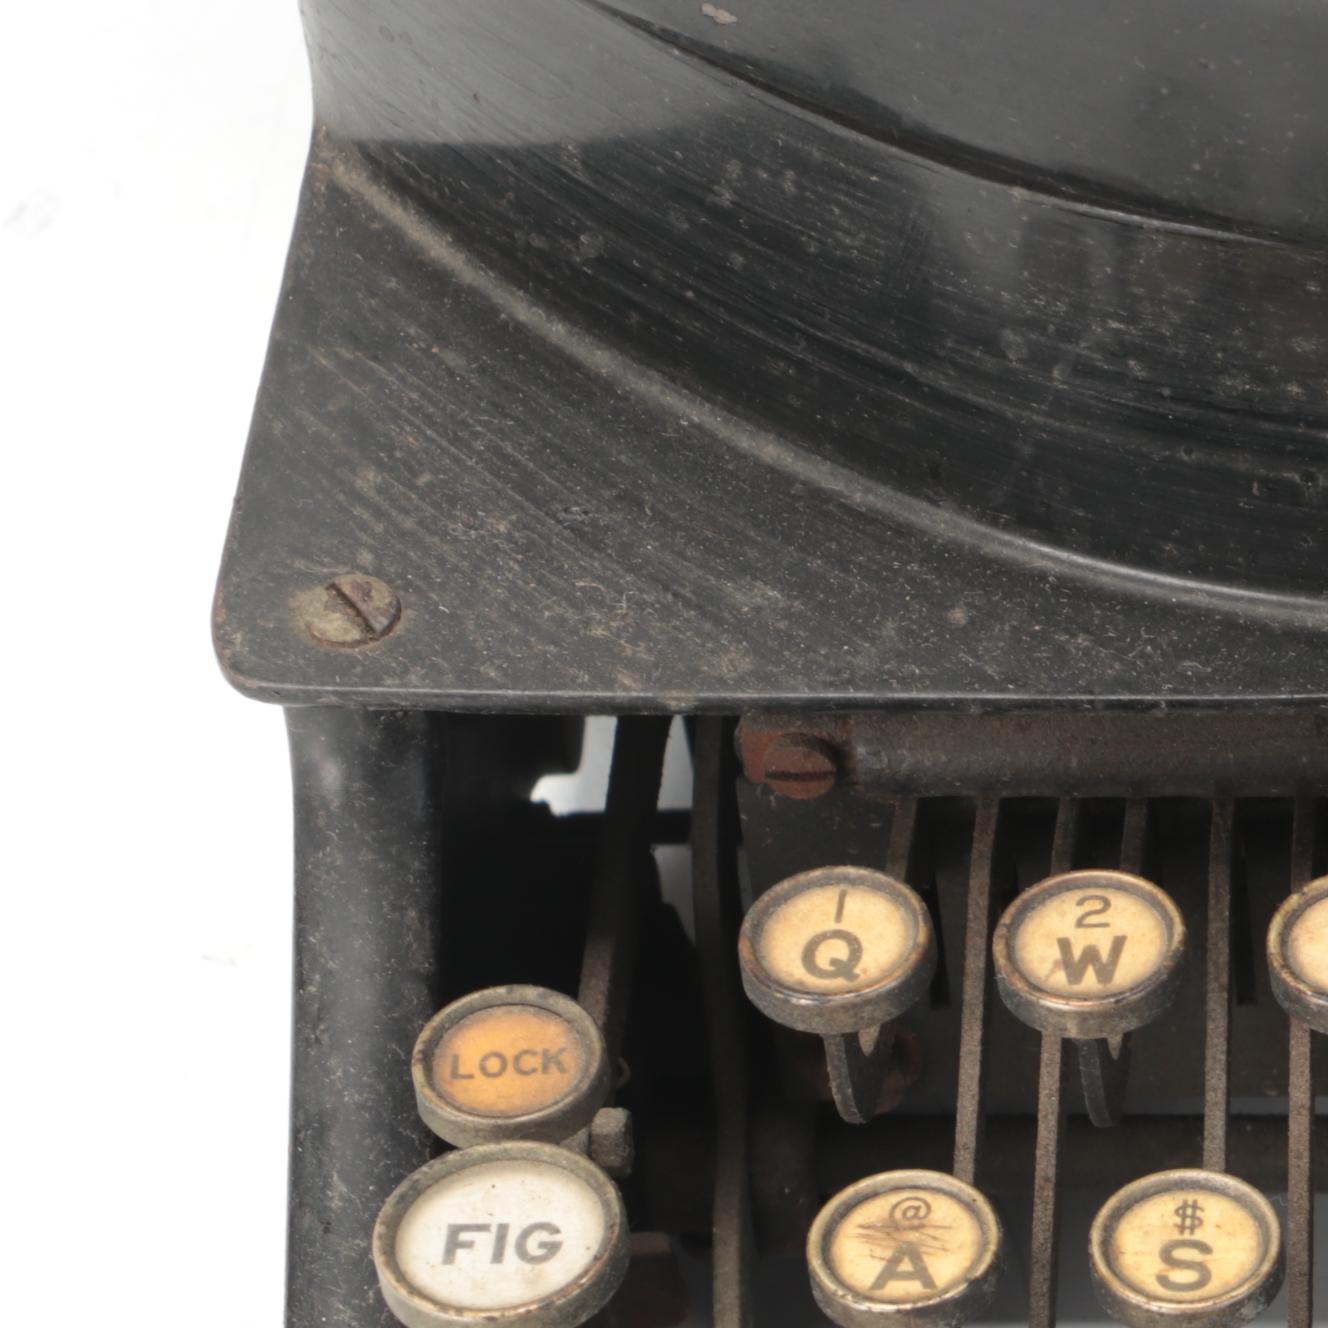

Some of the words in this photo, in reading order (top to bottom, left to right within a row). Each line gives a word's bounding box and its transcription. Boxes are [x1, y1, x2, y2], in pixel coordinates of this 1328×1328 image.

[1075, 895, 1111, 928] 2
[800, 928, 864, 982] Q
[1056, 935, 1128, 986] W
[450, 1045, 568, 1081] LOCK
[888, 1196, 932, 1227] @
[1173, 1199, 1205, 1236] $
[442, 1221, 563, 1265] FIG
[869, 1242, 937, 1291] A
[1155, 1239, 1213, 1293] S
